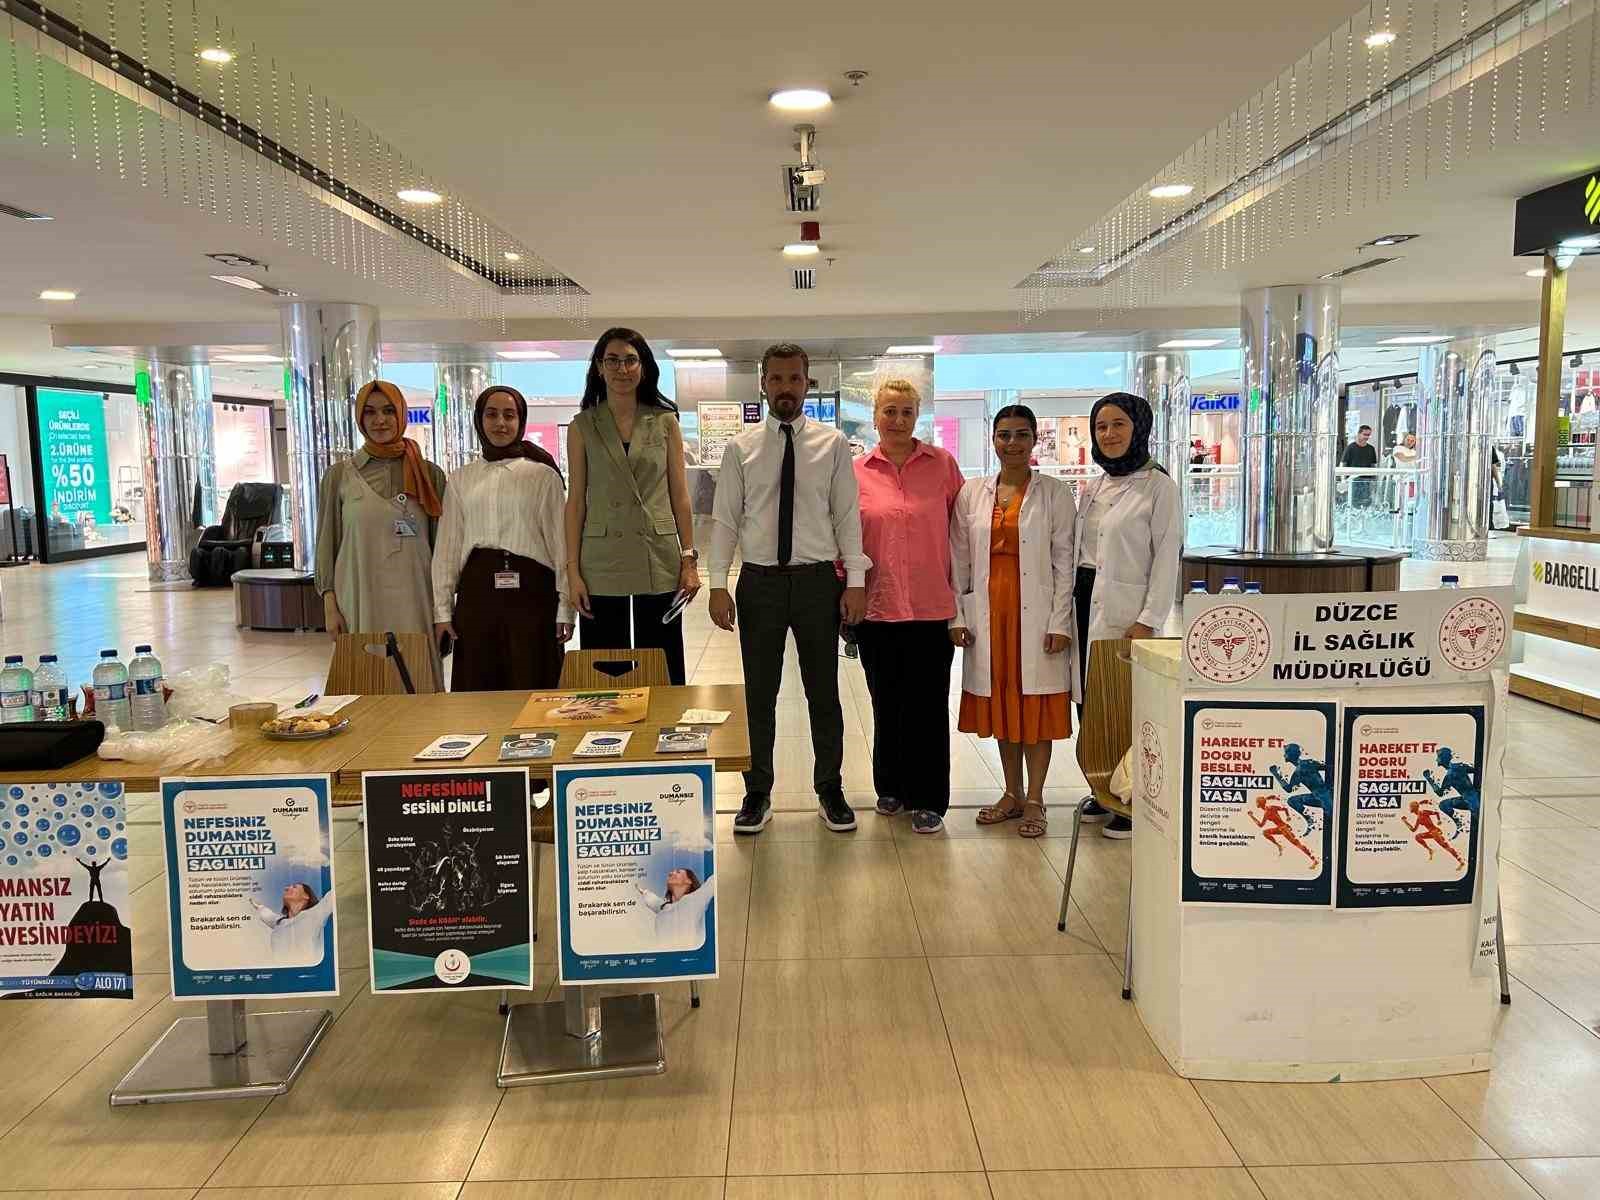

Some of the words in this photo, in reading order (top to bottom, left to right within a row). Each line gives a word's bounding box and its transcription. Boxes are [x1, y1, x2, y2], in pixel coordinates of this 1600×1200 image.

[52, 463, 95, 487] %50
[53, 488, 97, 503] İNDİRİM
[1315, 602, 1398, 622] DÜZCE
[1294, 631, 1316, 652] İL
[1324, 629, 1415, 651] SAĞLIK
[1273, 657, 1431, 680] MÜDÜRLÜĞÜ
[1201, 737, 1265, 748] HAREKET
[1359, 743, 1419, 754] HAREKET
[1200, 763, 1256, 775] BESLEN,
[401, 780, 485, 798] NEFESİNİN
[402, 800, 445, 815] SESİNİ
[576, 815, 657, 830] DUMANSIZ
[185, 830, 272, 843] DUMANSIZ
[578, 829, 659, 843] HAYATINIZ
[188, 843, 274, 857] HAYATINIZ
[0, 902, 54, 921] YATIN
[95, 977, 112, 990] ALO
[114, 977, 127, 991] 171
